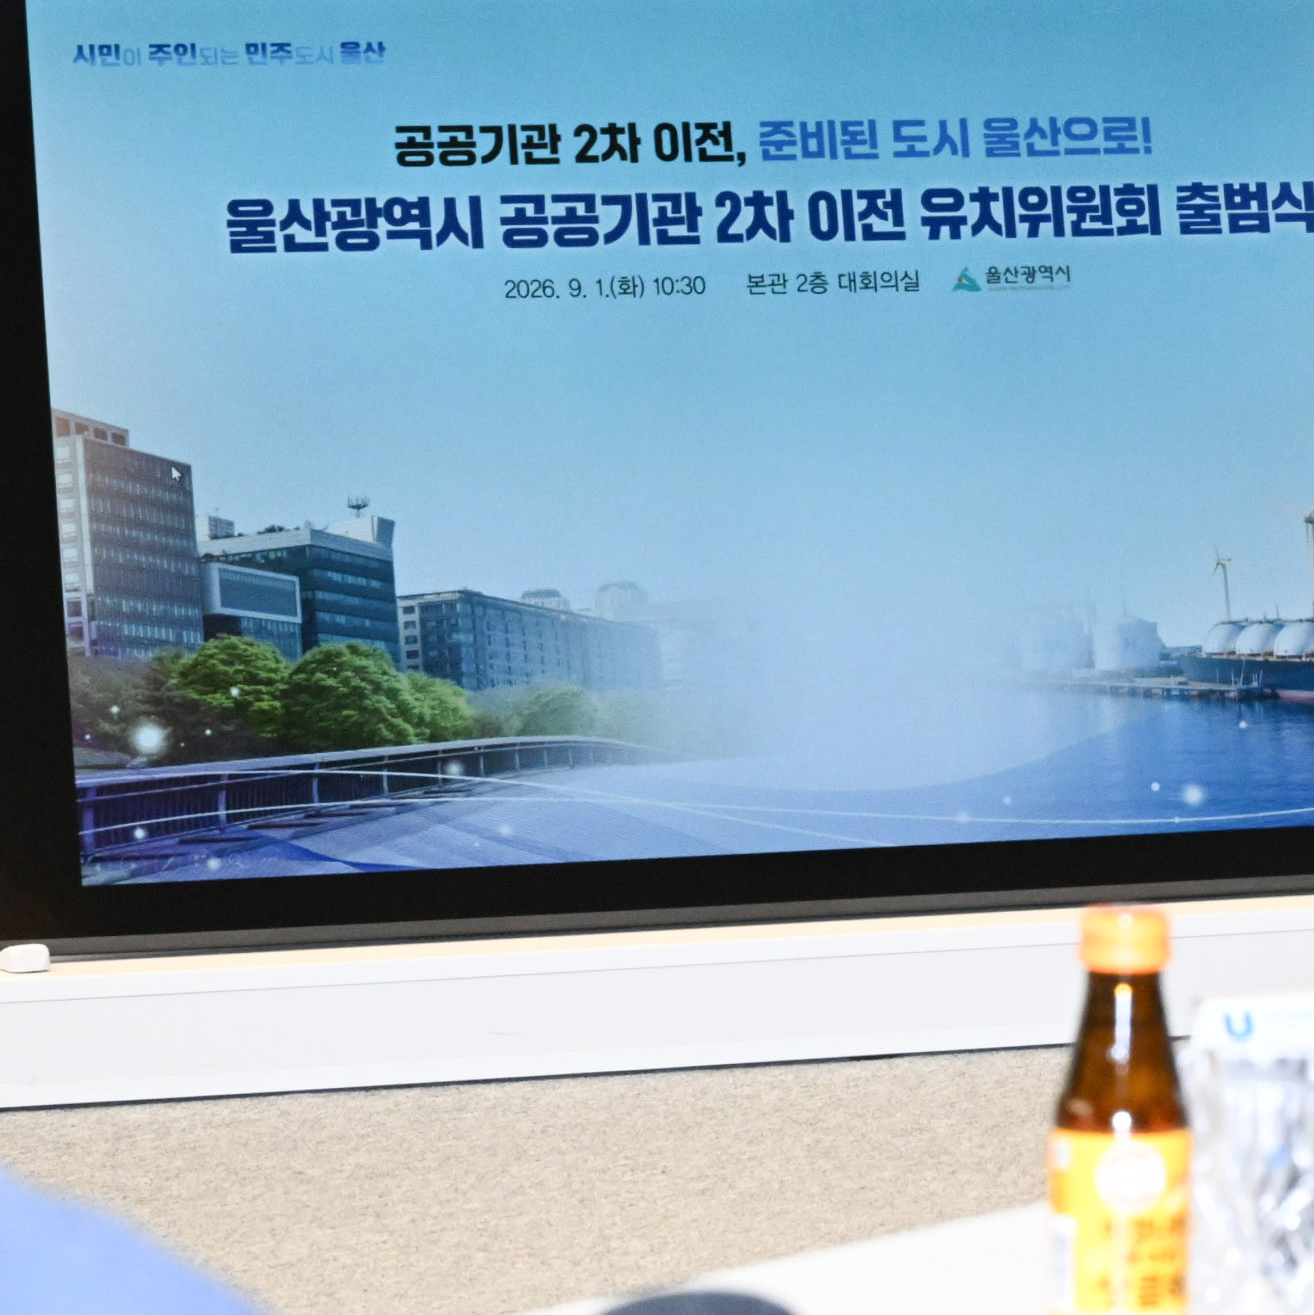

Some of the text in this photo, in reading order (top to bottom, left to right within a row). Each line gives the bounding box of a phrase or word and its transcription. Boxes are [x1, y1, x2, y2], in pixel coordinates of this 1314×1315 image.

[72, 42, 141, 67] 시민이
[148, 42, 239, 67] 주인되는
[339, 40, 387, 65] 울산
[394, 116, 1153, 168] 공공기관 2차 이전, 준비된 도시 울산으로!
[226, 195, 485, 254] 울산광역시
[499, 192, 703, 249] 공공기관
[714, 189, 795, 244] 2차
[807, 187, 907, 242] 이전
[920, 182, 1162, 241] 유치위원회
[504, 269, 921, 300] 2026. 9. 1.(화) 10:30 본관 2층 대회의실
[985, 264, 1071, 285] 울산광역시
